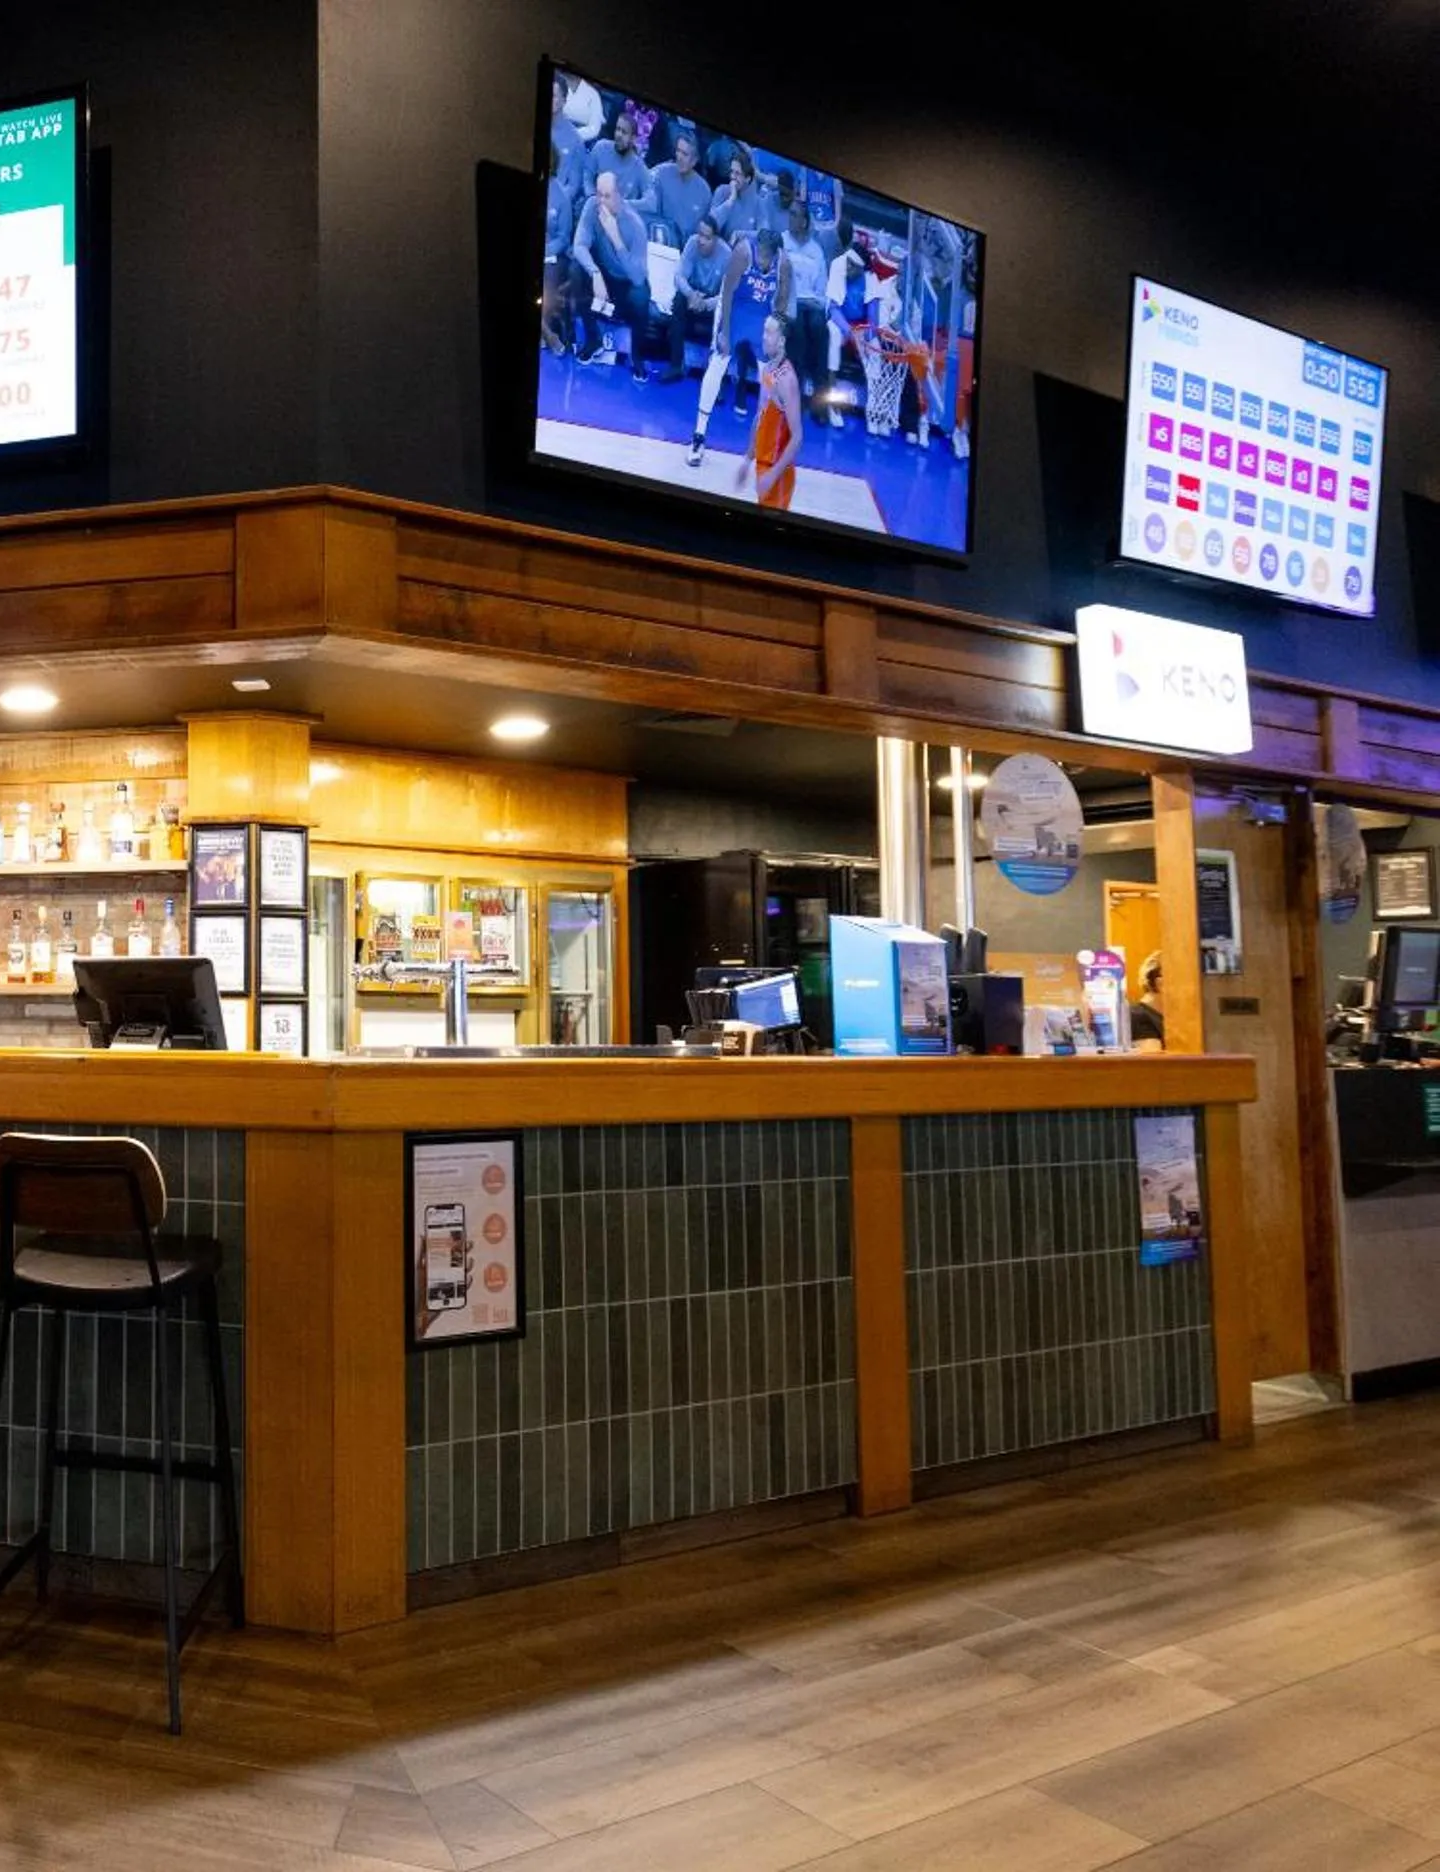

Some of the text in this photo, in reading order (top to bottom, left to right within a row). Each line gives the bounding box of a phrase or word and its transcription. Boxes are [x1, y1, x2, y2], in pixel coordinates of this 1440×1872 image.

[39, 112, 63, 127] LIVE
[31, 123, 63, 141] APP
[1161, 662, 1237, 704] KENO
